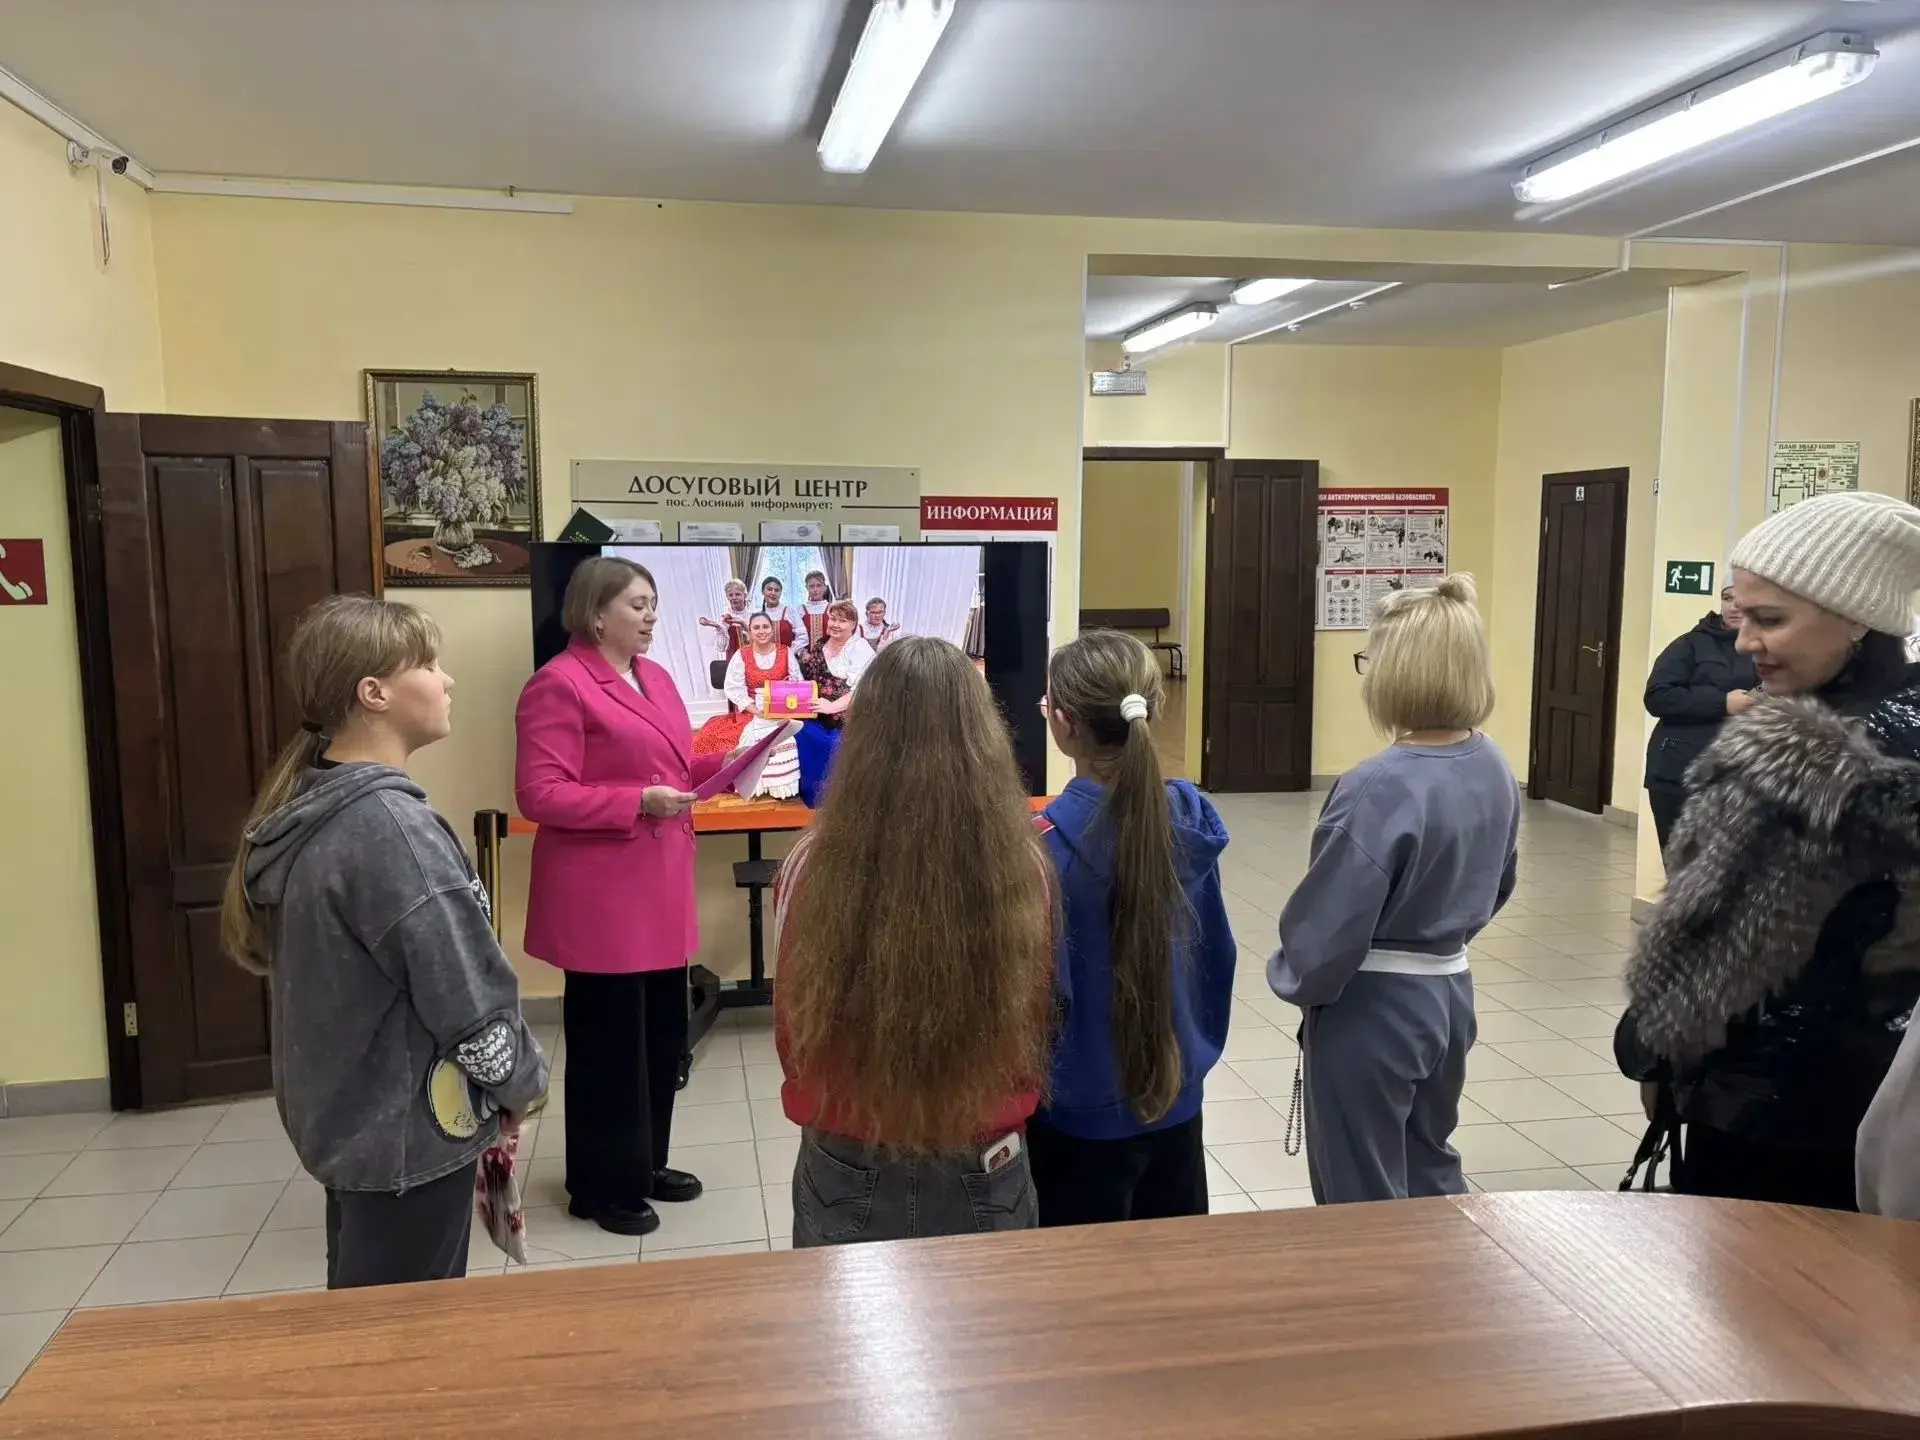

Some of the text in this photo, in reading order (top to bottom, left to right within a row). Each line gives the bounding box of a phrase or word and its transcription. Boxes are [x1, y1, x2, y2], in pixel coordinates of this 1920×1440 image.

[628, 474, 868, 498] ДОСУГОВЫЙ ЦЕНТР
[750, 498, 833, 512] информирует:
[926, 505, 1054, 522] ИНФОРМАЦИЯ
